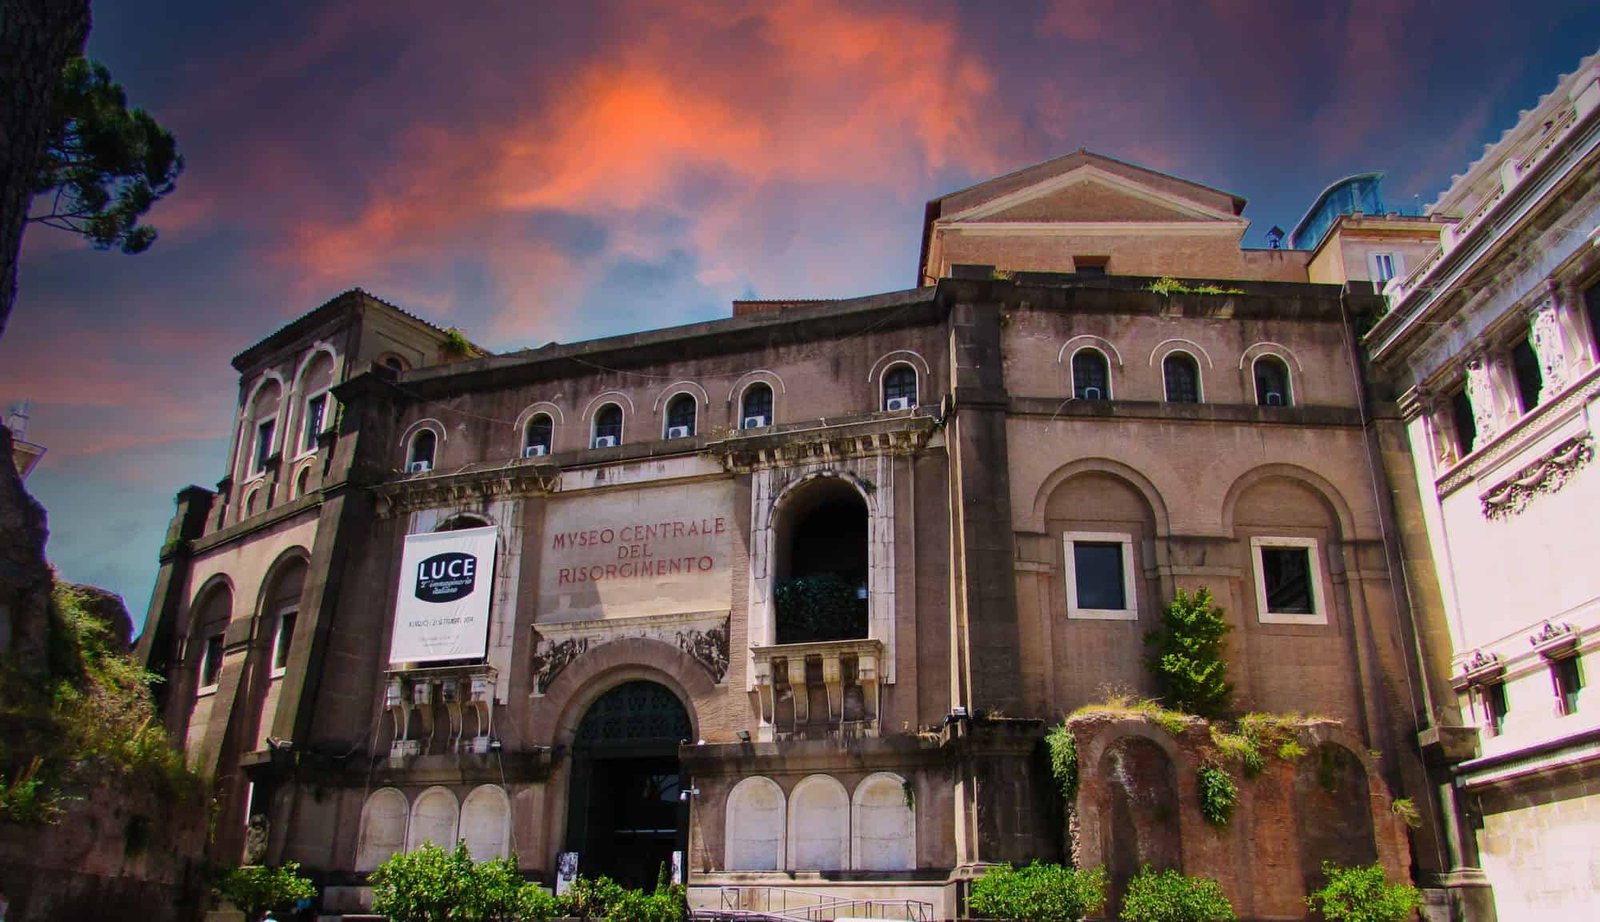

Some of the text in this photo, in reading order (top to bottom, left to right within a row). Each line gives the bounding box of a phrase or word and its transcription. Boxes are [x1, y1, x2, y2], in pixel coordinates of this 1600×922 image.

[552, 517, 726, 549] MVSEO CENTRALE
[617, 543, 654, 560] DEL
[419, 558, 475, 581] LUCE
[558, 555, 714, 586] RISORGIMENTO
